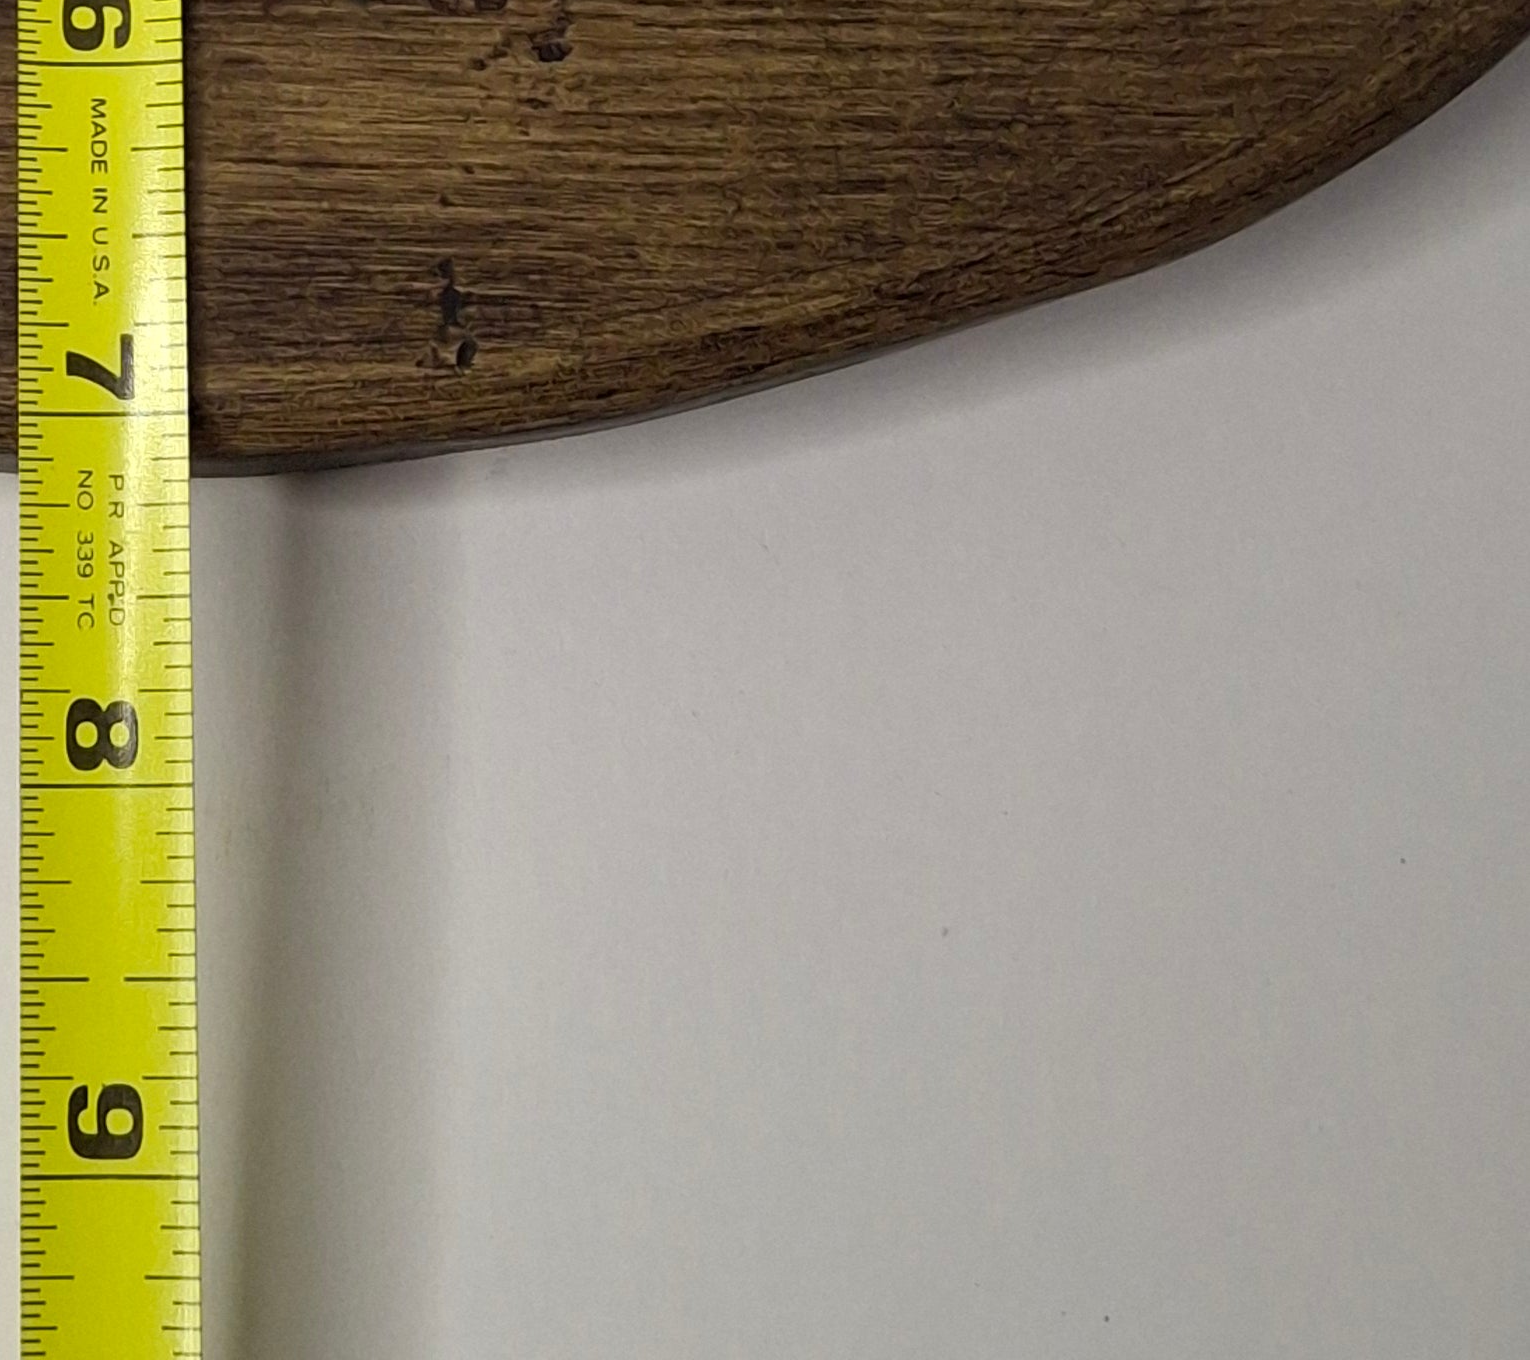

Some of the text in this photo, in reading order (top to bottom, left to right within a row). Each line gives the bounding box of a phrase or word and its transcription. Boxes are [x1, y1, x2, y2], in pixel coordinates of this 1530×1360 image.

[90, 97, 108, 174] MADE
[92, 187, 108, 214] IN
[65, 333, 136, 401] 7
[77, 469, 95, 630] NO 339 TC
[66, 698, 138, 771] 8
[67, 1082, 143, 1160] 9
